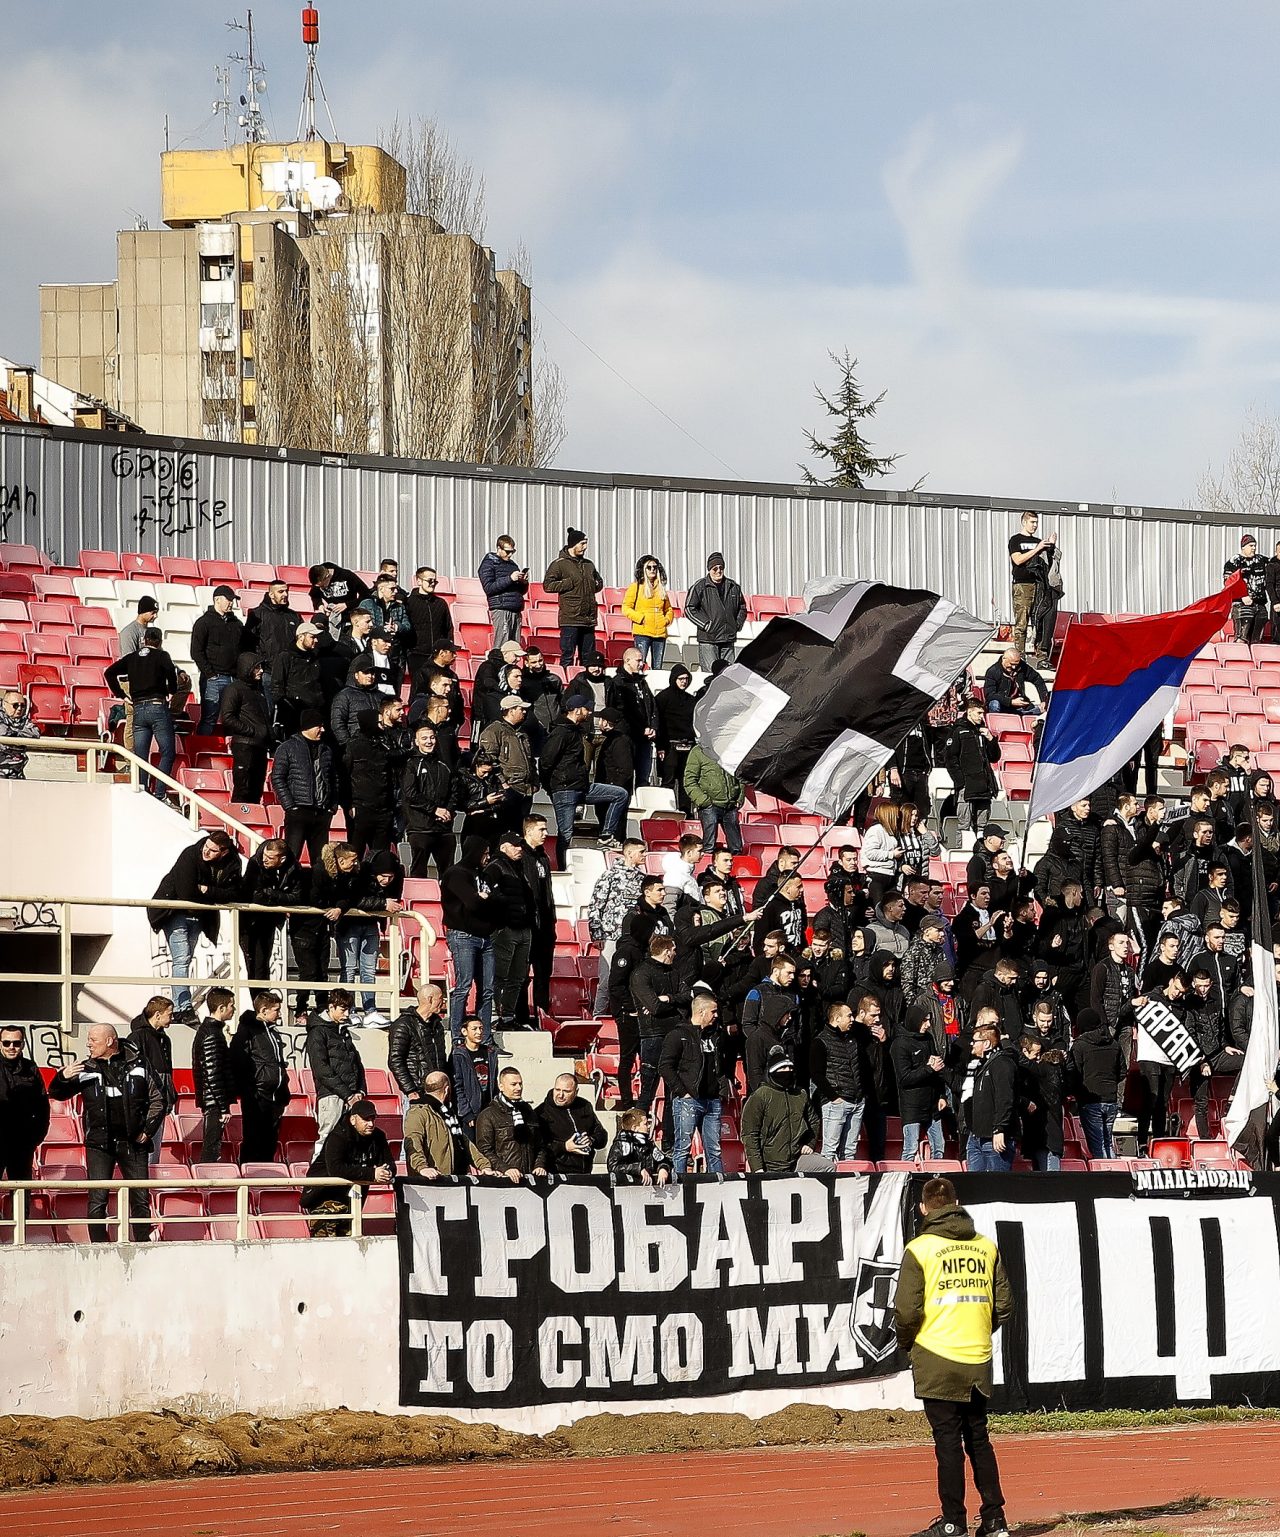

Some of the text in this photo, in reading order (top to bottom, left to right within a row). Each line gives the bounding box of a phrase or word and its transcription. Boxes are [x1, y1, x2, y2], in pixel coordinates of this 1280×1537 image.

[1136, 1169, 1251, 1191] МЛАДЕНОВАЦ
[402, 1171, 909, 1297] ГРОБАРИ
[942, 1257, 987, 1275] NIFON
[938, 1278, 989, 1291] SECURITY
[408, 1302, 864, 1393] ТО СМО МИ
